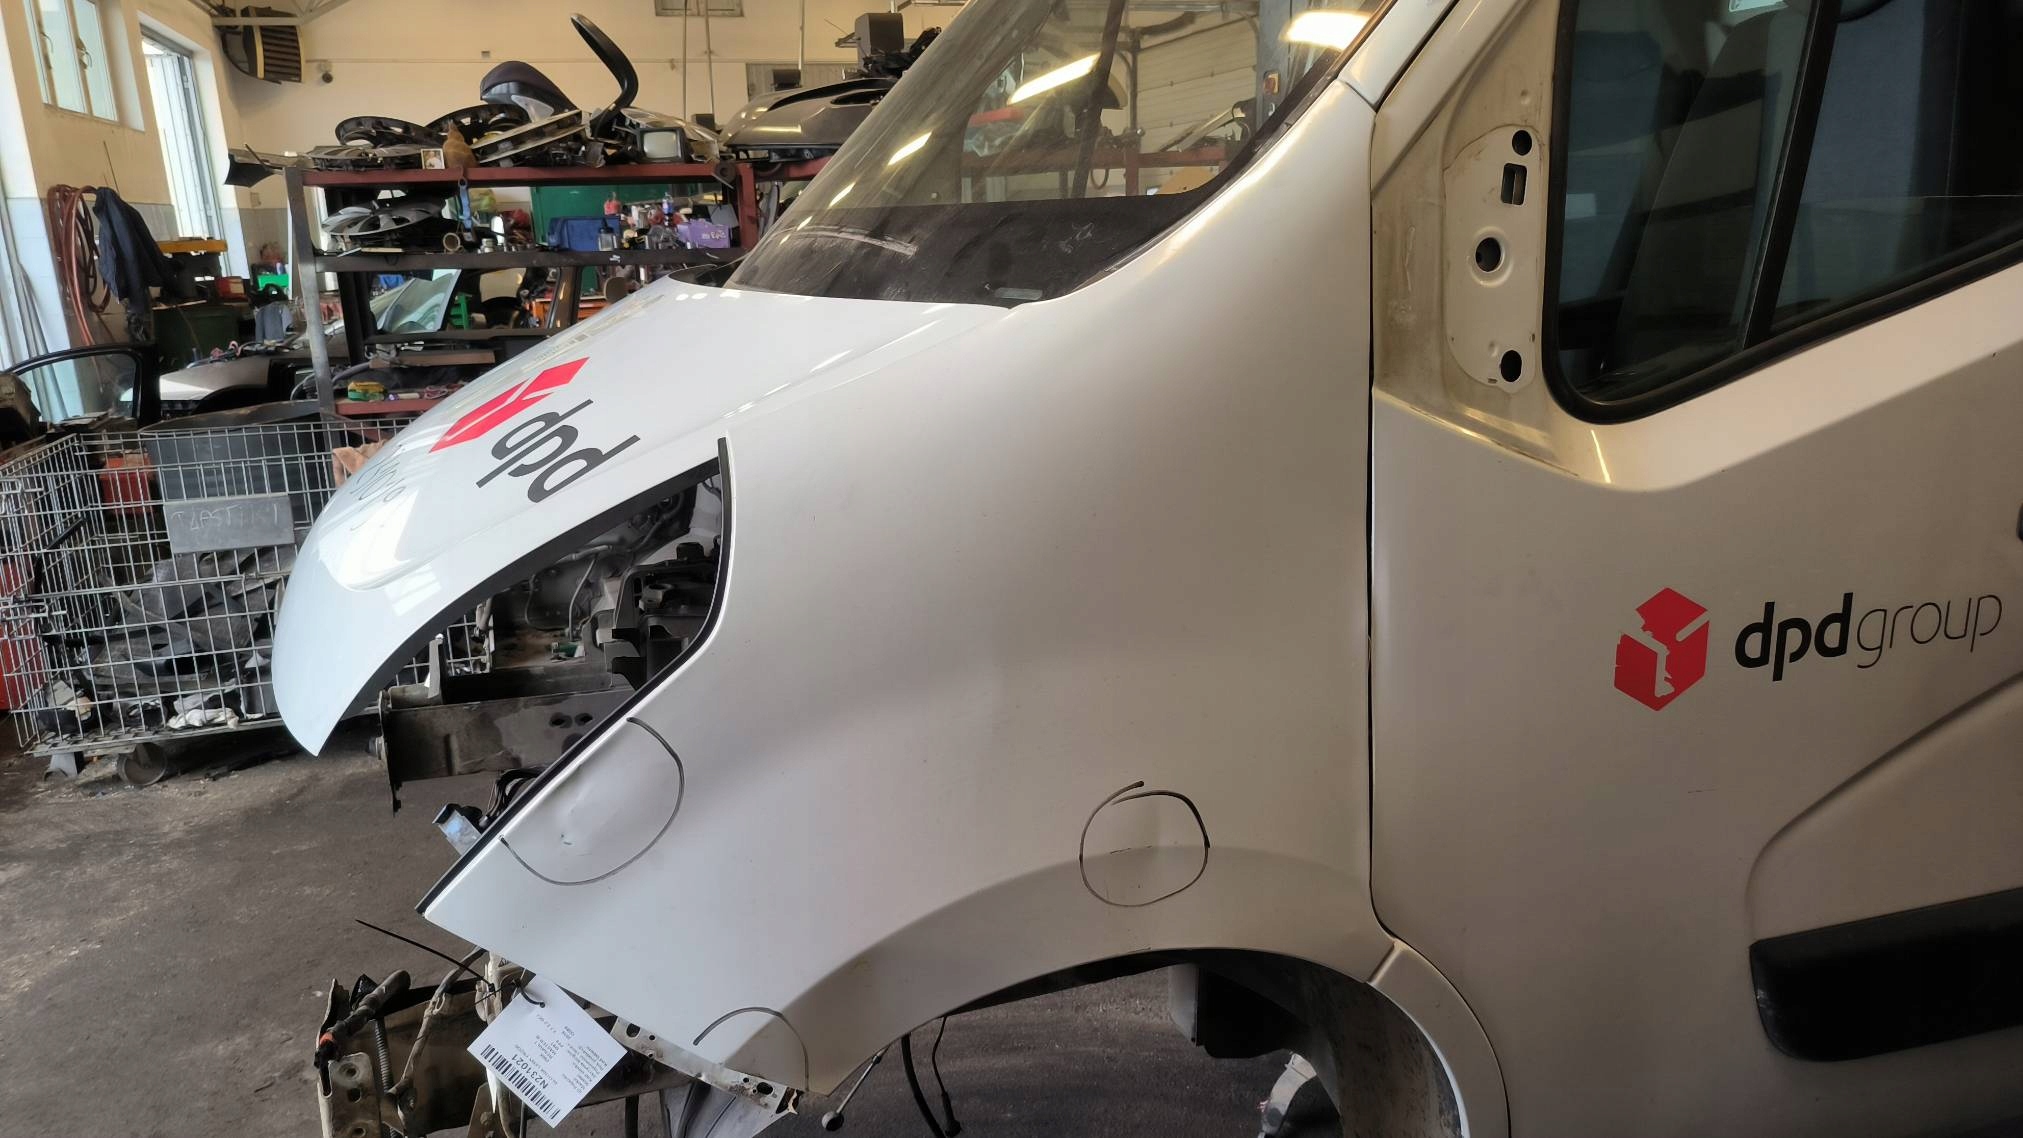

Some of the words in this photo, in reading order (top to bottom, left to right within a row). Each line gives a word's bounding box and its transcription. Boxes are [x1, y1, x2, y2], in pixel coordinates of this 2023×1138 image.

[476, 399, 640, 503] dpd
[1735, 592, 2003, 682] dpdgroup
[511, 1053, 549, 1089] N231021
